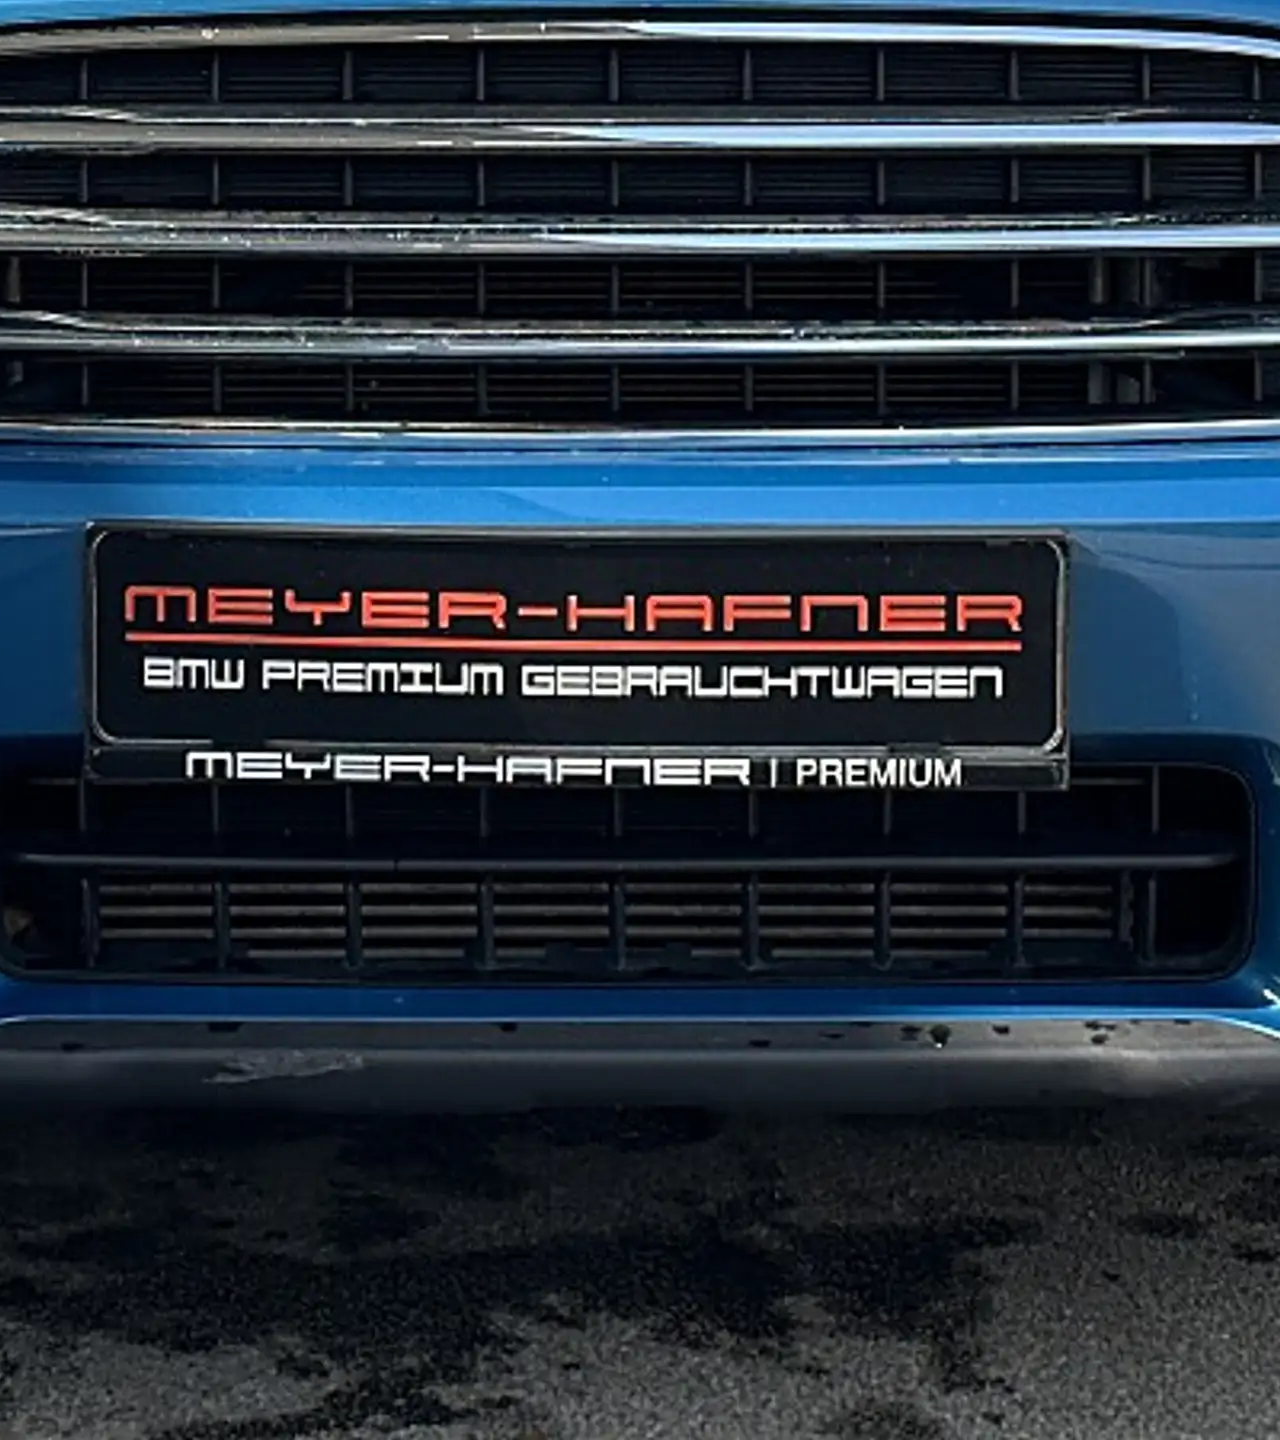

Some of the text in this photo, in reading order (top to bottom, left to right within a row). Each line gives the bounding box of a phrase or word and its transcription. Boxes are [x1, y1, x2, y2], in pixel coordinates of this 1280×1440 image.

[124, 584, 1023, 633] MEYER-HAFNER
[142, 656, 1004, 700] BMW PREMIUM GEBRAUCHTWAGEN
[184, 750, 963, 789] MEYER-HAFNER PREMIUM
